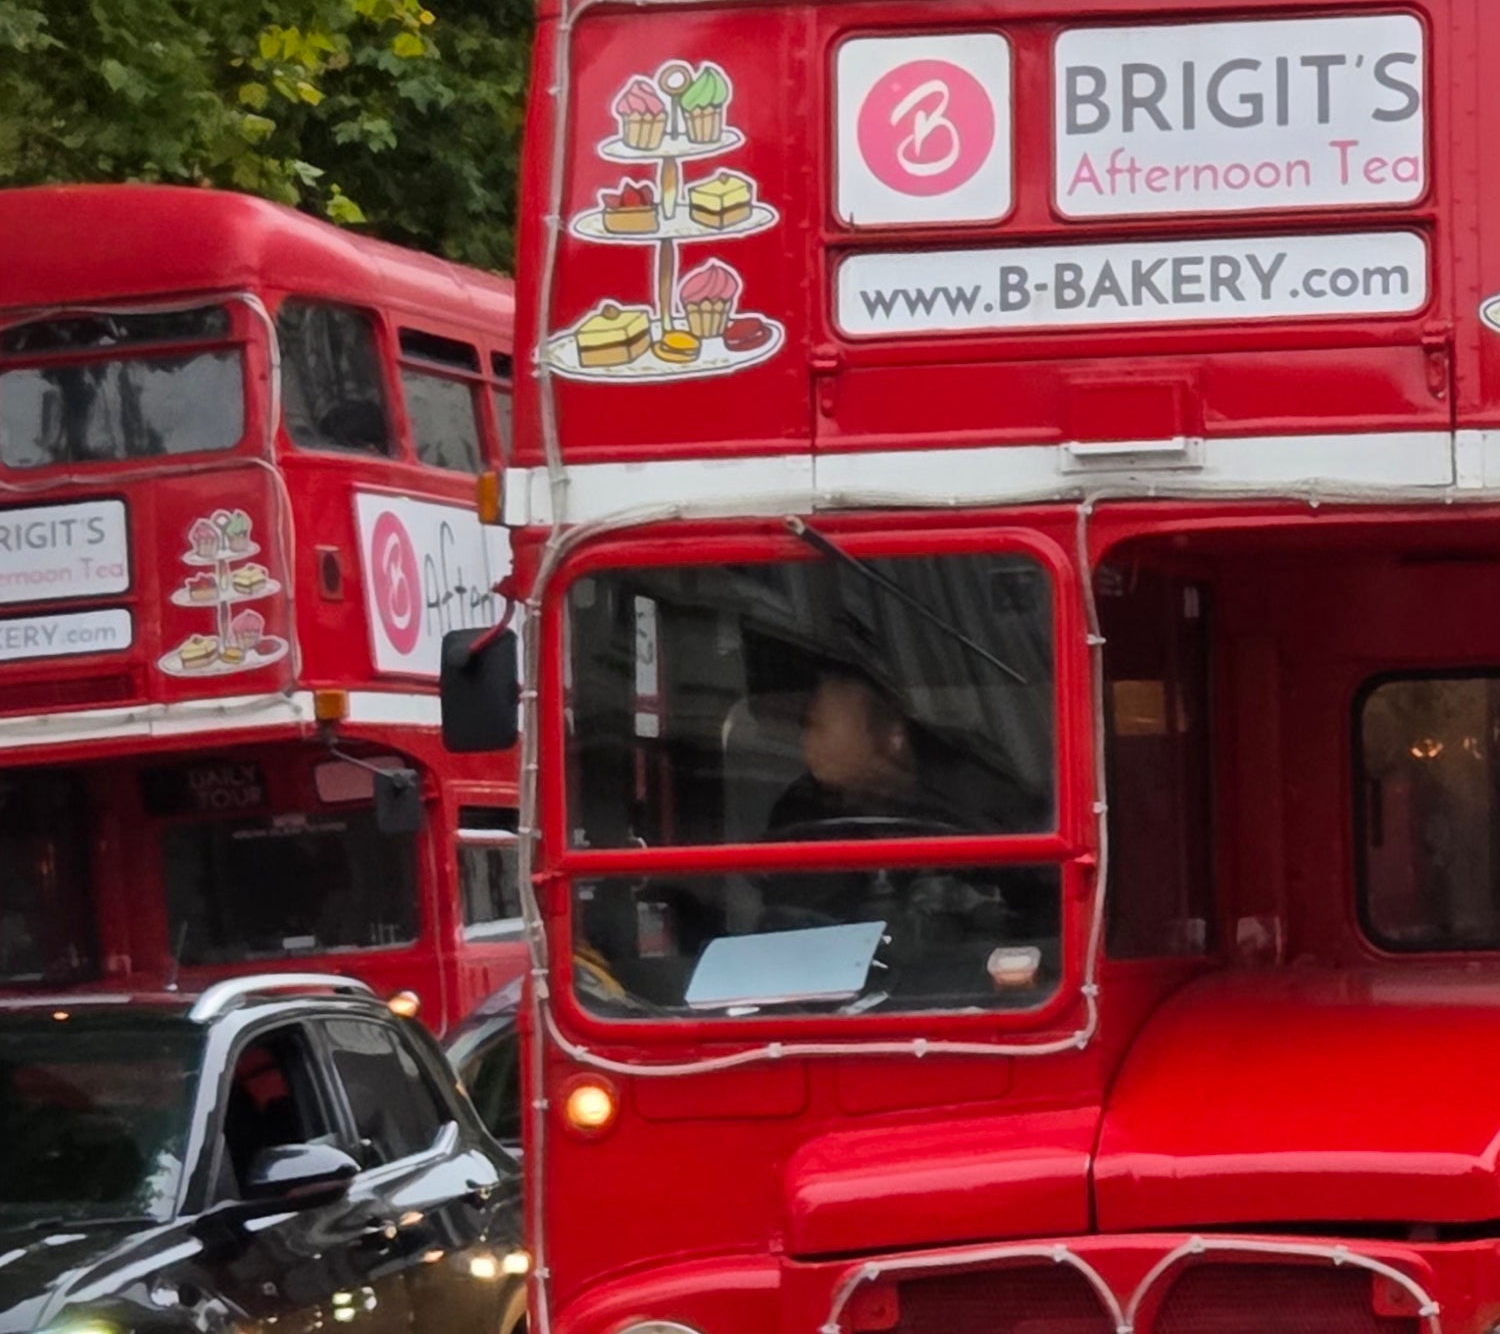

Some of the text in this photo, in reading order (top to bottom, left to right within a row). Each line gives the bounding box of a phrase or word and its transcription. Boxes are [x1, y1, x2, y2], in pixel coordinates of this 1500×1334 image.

[1065, 52, 1420, 135] BRIGIT'S
[1067, 140, 1419, 196] Afternoon Tea
[860, 253, 1410, 319] www.B-BAKERY.com
